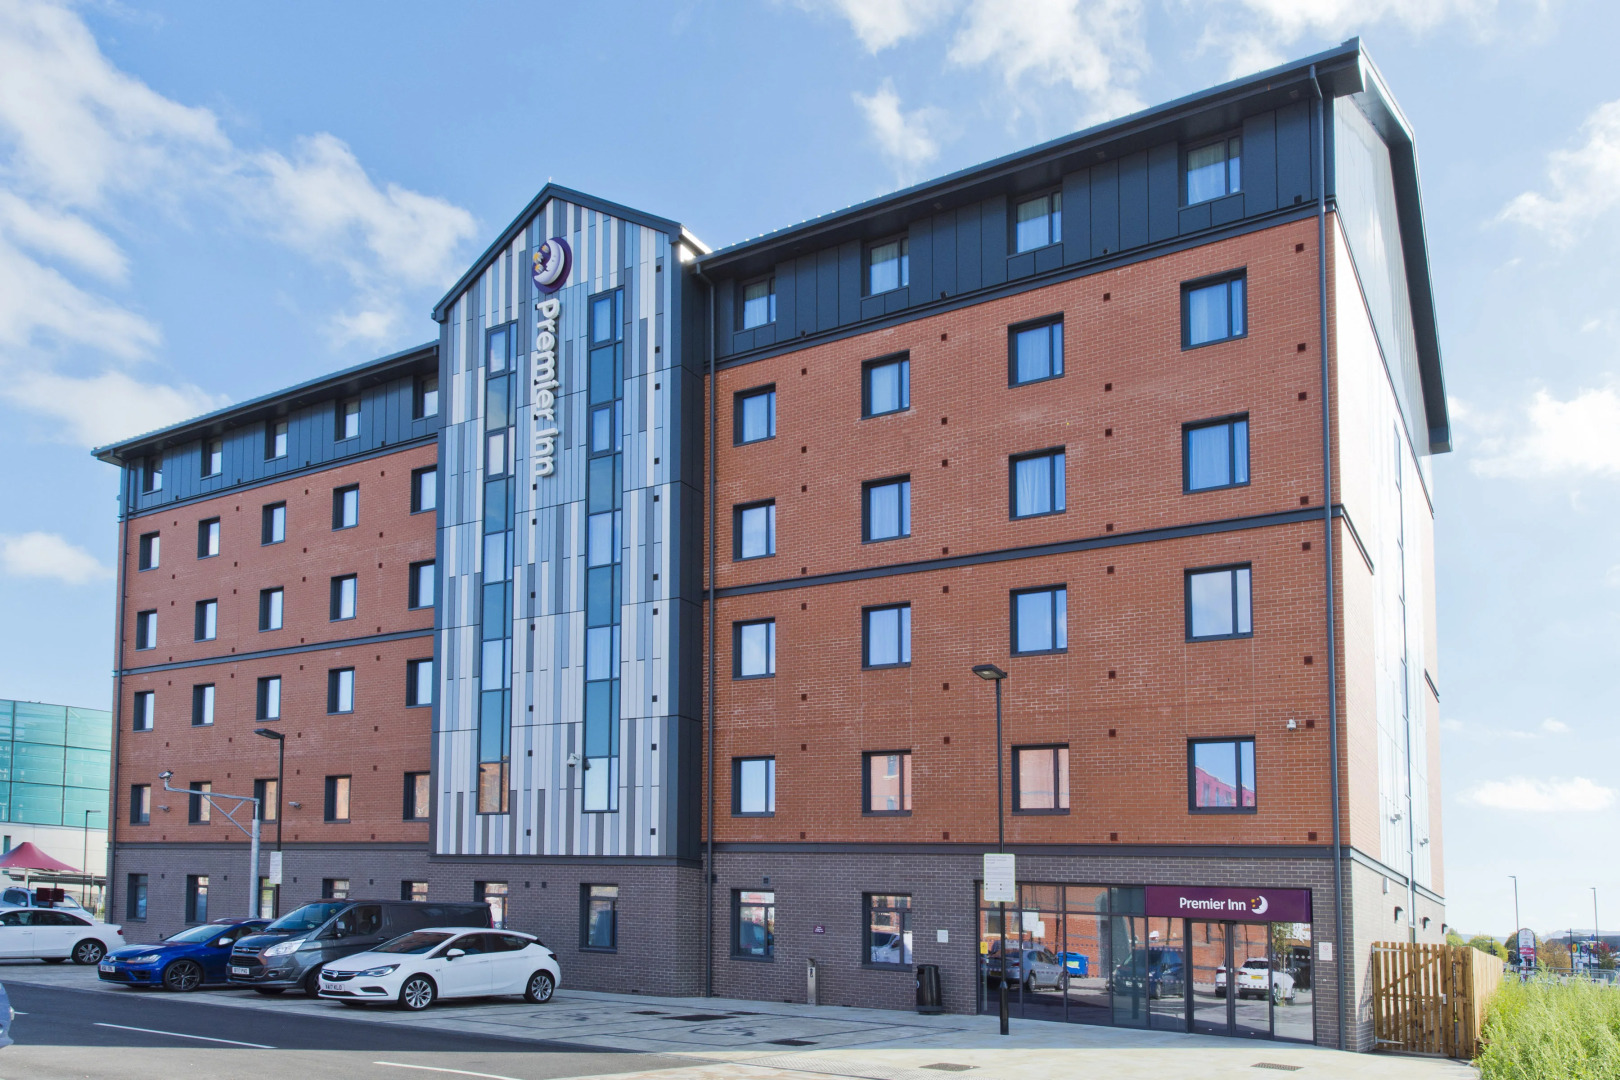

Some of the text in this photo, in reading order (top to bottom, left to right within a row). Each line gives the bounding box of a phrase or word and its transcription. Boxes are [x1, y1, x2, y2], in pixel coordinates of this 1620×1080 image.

[535, 298, 560, 477] Premier Inn
[1179, 897, 1247, 911] Premier Inn
